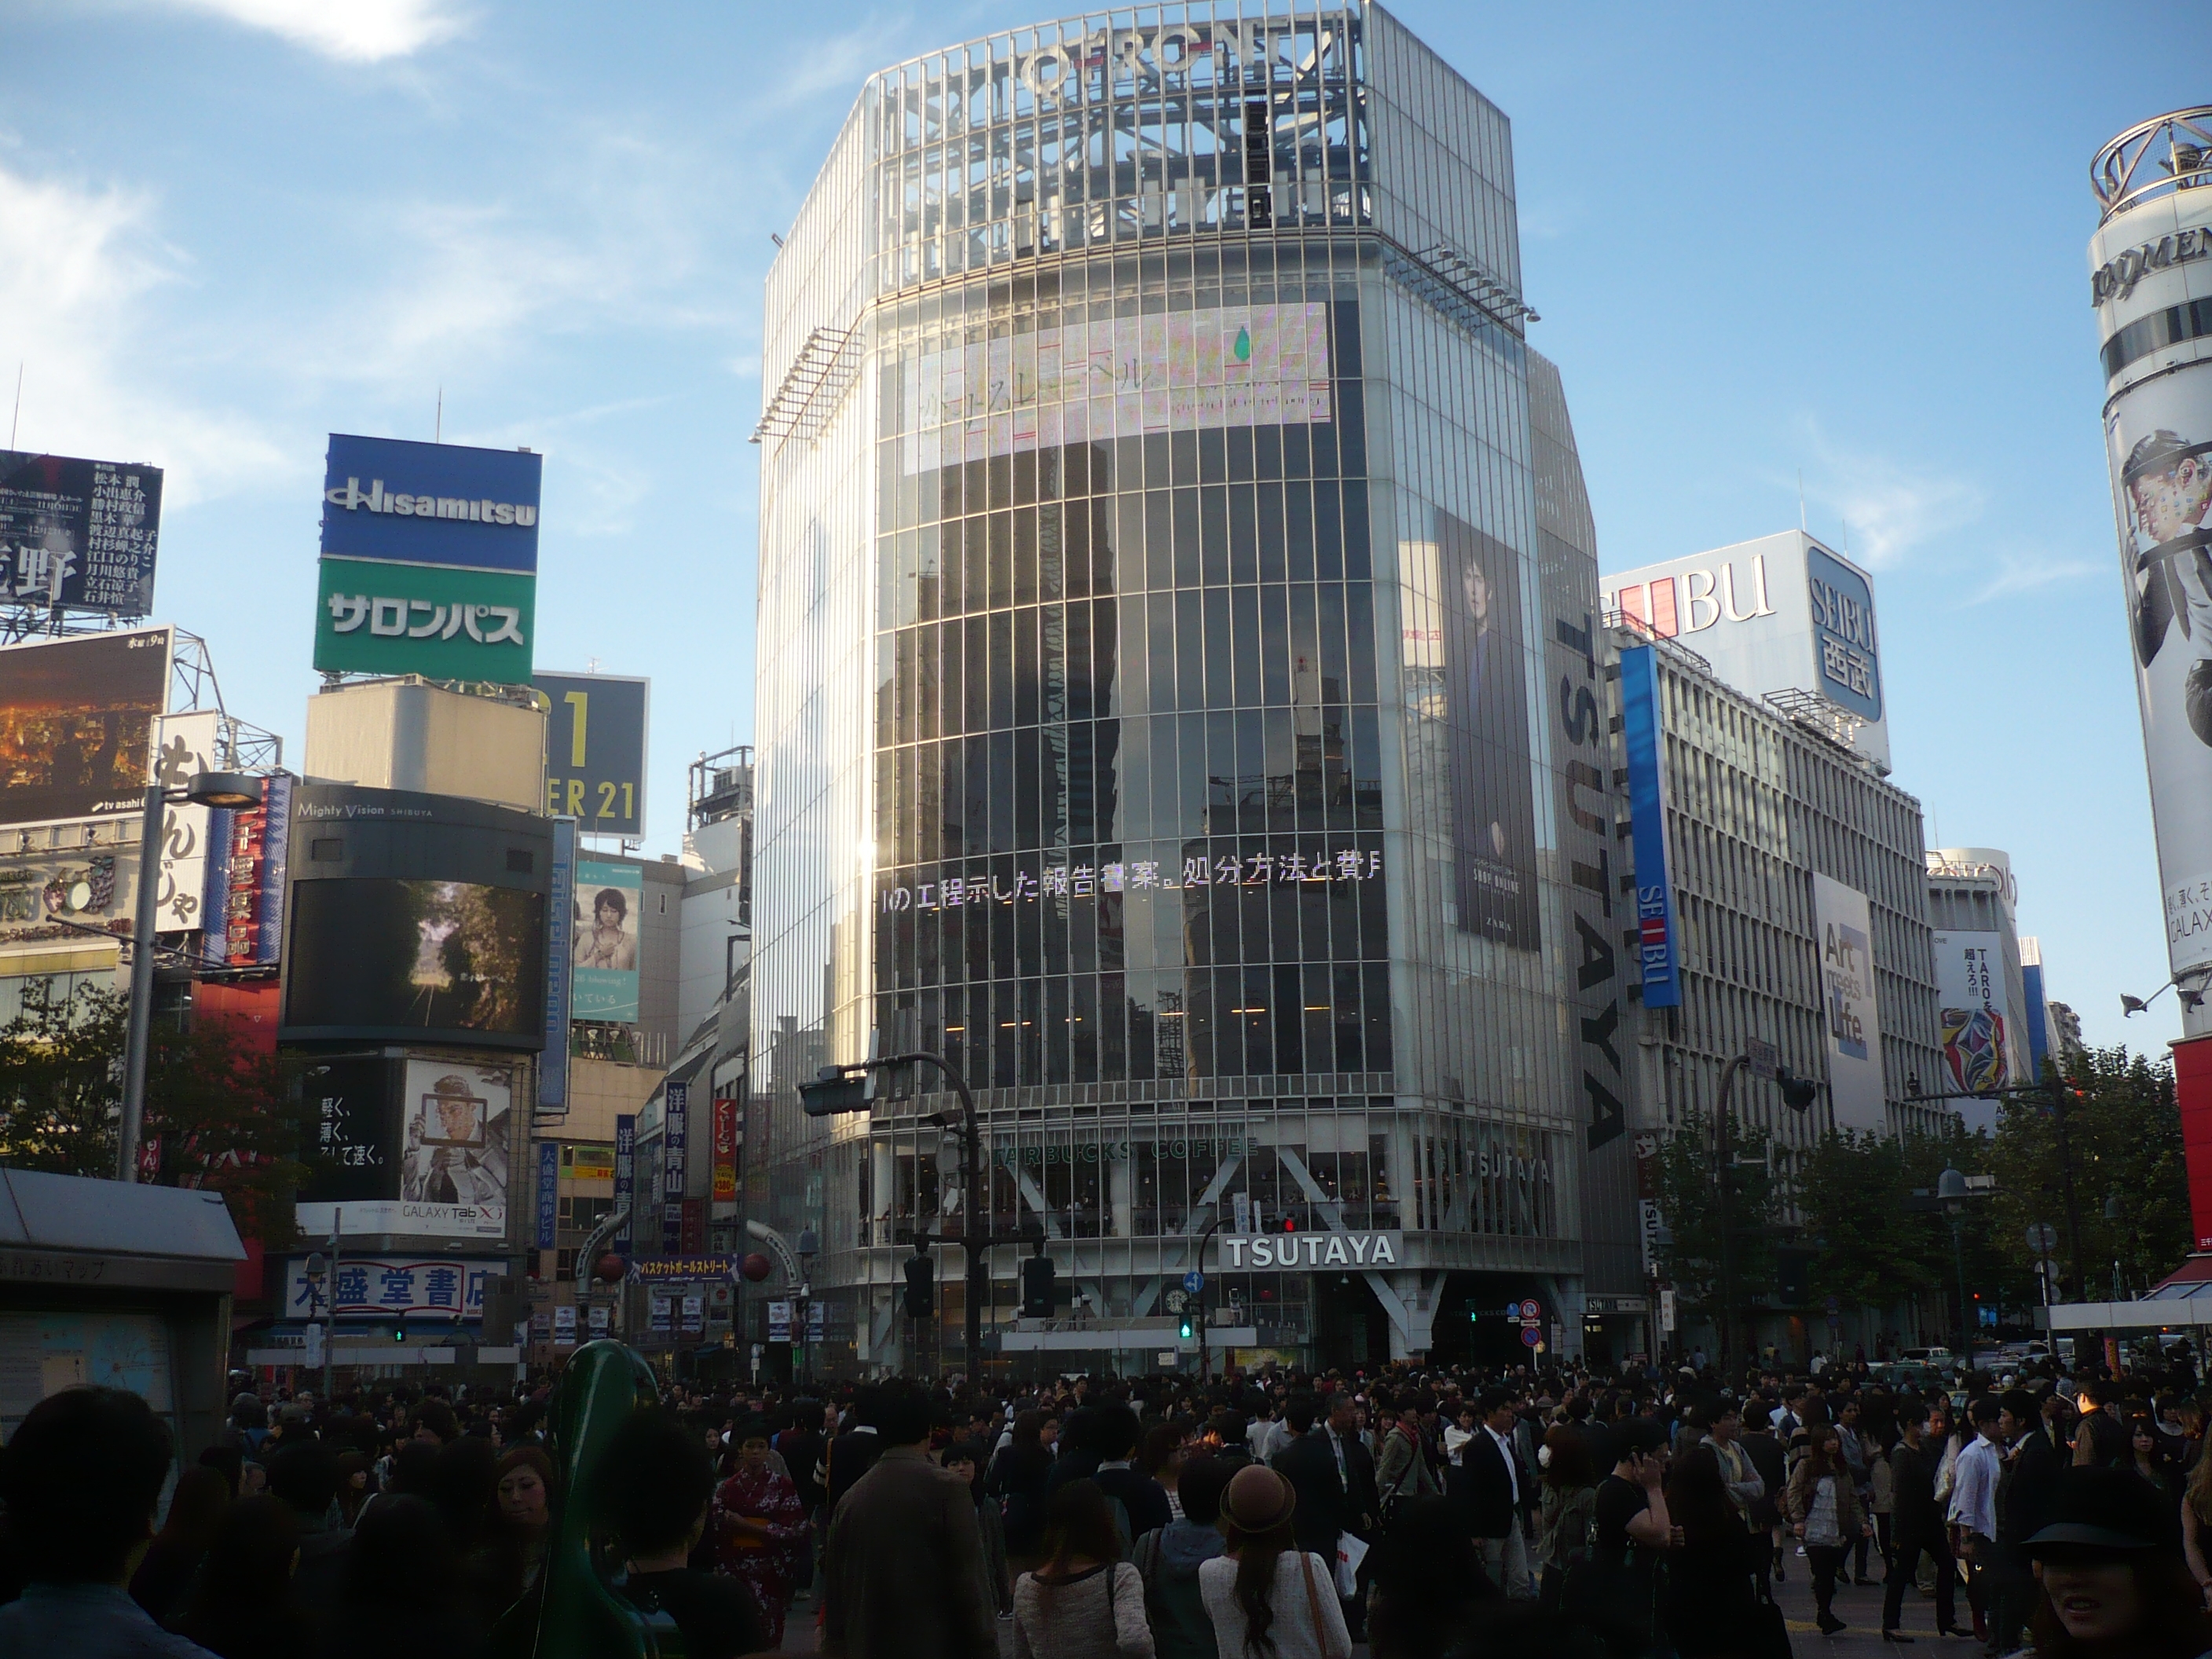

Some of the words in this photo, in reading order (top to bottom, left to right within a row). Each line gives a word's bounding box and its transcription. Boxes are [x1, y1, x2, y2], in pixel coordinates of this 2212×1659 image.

[326, 476, 537, 526] Hisamitsu
[0, 544, 78, 602] 野
[328, 592, 524, 646] サロンパス
[1810, 576, 1876, 657] SEIBU
[1821, 632, 1873, 700] 西武
[115, 798, 140, 809] asahi
[298, 802, 342, 818] Mighty
[345, 804, 385, 819] Vision
[390, 808, 433, 817] SHIBUYA
[597, 782, 633, 819] 21
[1544, 611, 1625, 1154] TSUTAYA
[1486, 917, 1512, 932] ZARA
[1638, 884, 1668, 987] SEIBU
[1825, 922, 1855, 974] Art
[1826, 968, 1861, 1002] meets
[1976, 948, 1993, 1013] TAROを
[1828, 996, 1863, 1046] Life
[666, 1088, 686, 1193] 洋服の青山
[991, 1141, 1136, 1166] TARBUCKS
[1151, 1137, 1259, 1160] COFFEE
[615, 1127, 634, 1242] 洋服の青山
[1467, 1149, 1551, 1184] TSUTAYA
[403, 1205, 449, 1218] GALAXY
[452, 1207, 477, 1218] Tab
[539, 1150, 556, 1243] 大盛堂商事ビル
[641, 1258, 729, 1275] バスケットボールストリート
[1225, 1236, 1396, 1268] TSUTAYA
[1588, 1298, 1617, 1313] TSUTAYA
